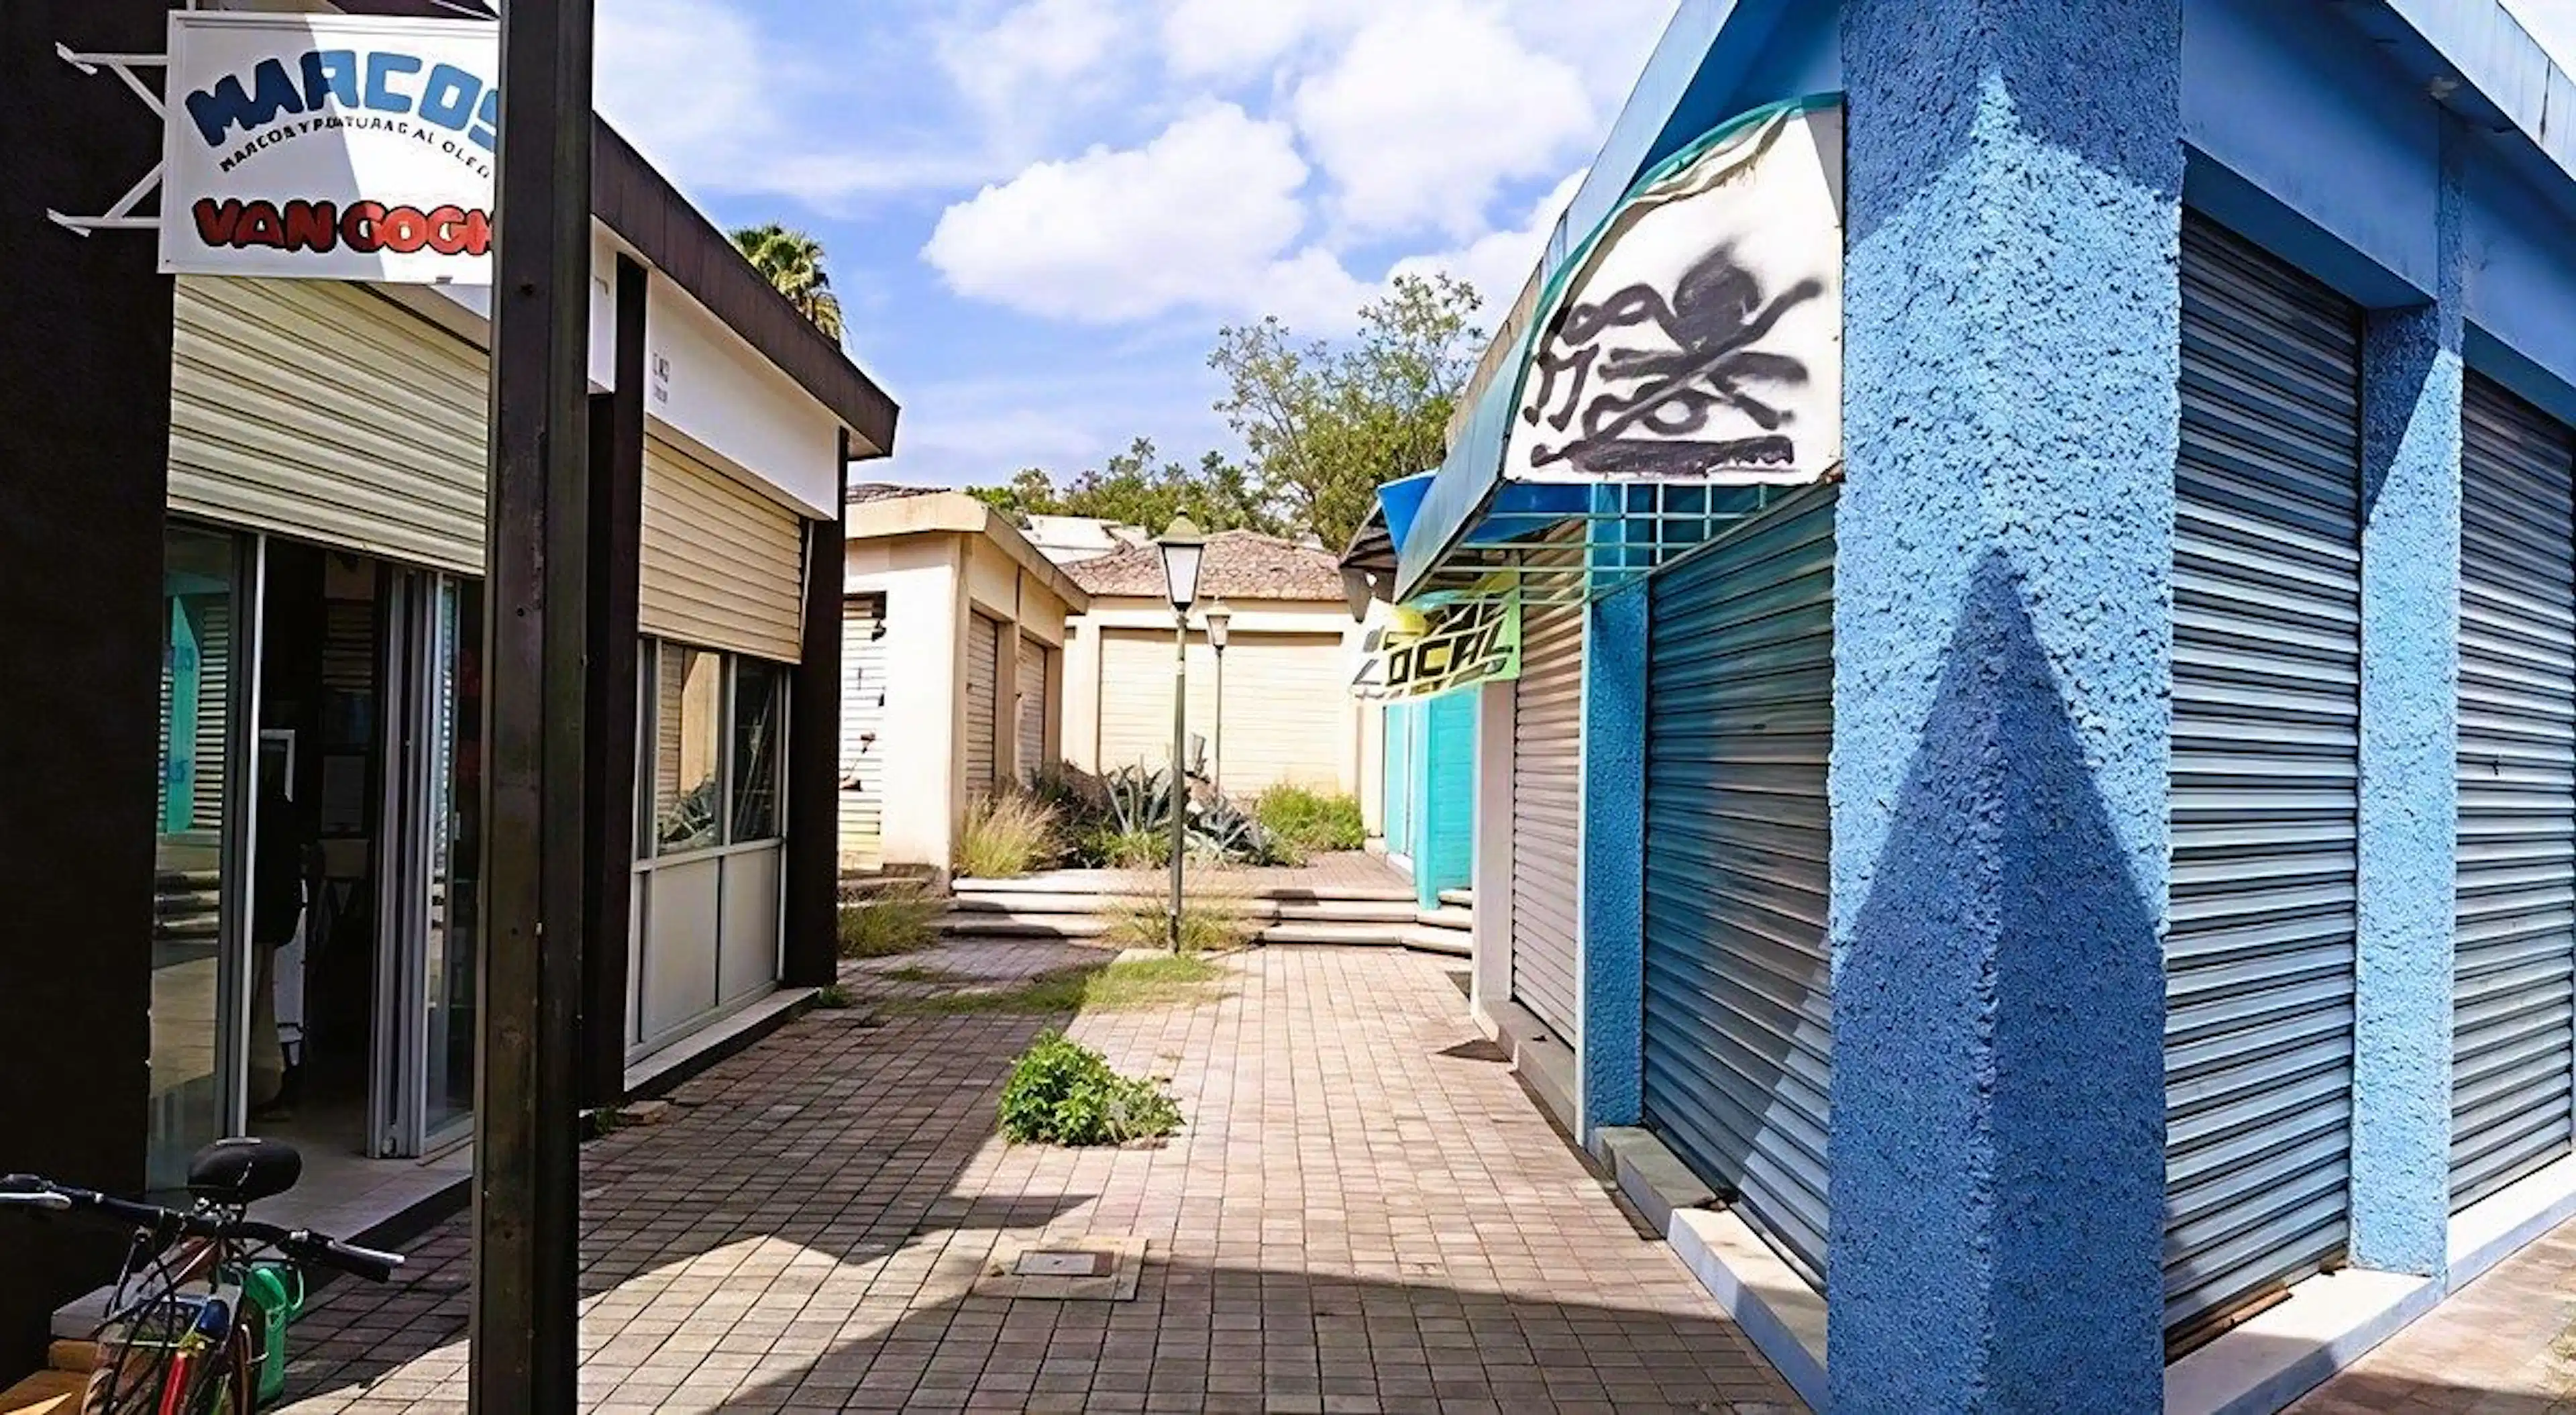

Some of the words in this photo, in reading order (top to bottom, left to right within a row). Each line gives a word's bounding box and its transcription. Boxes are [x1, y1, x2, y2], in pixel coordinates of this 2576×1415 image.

[299, 120, 311, 133] Y
[412, 127, 434, 144] AL
[193, 198, 337, 253] VAN
[1352, 624, 1514, 687] LOCAL
